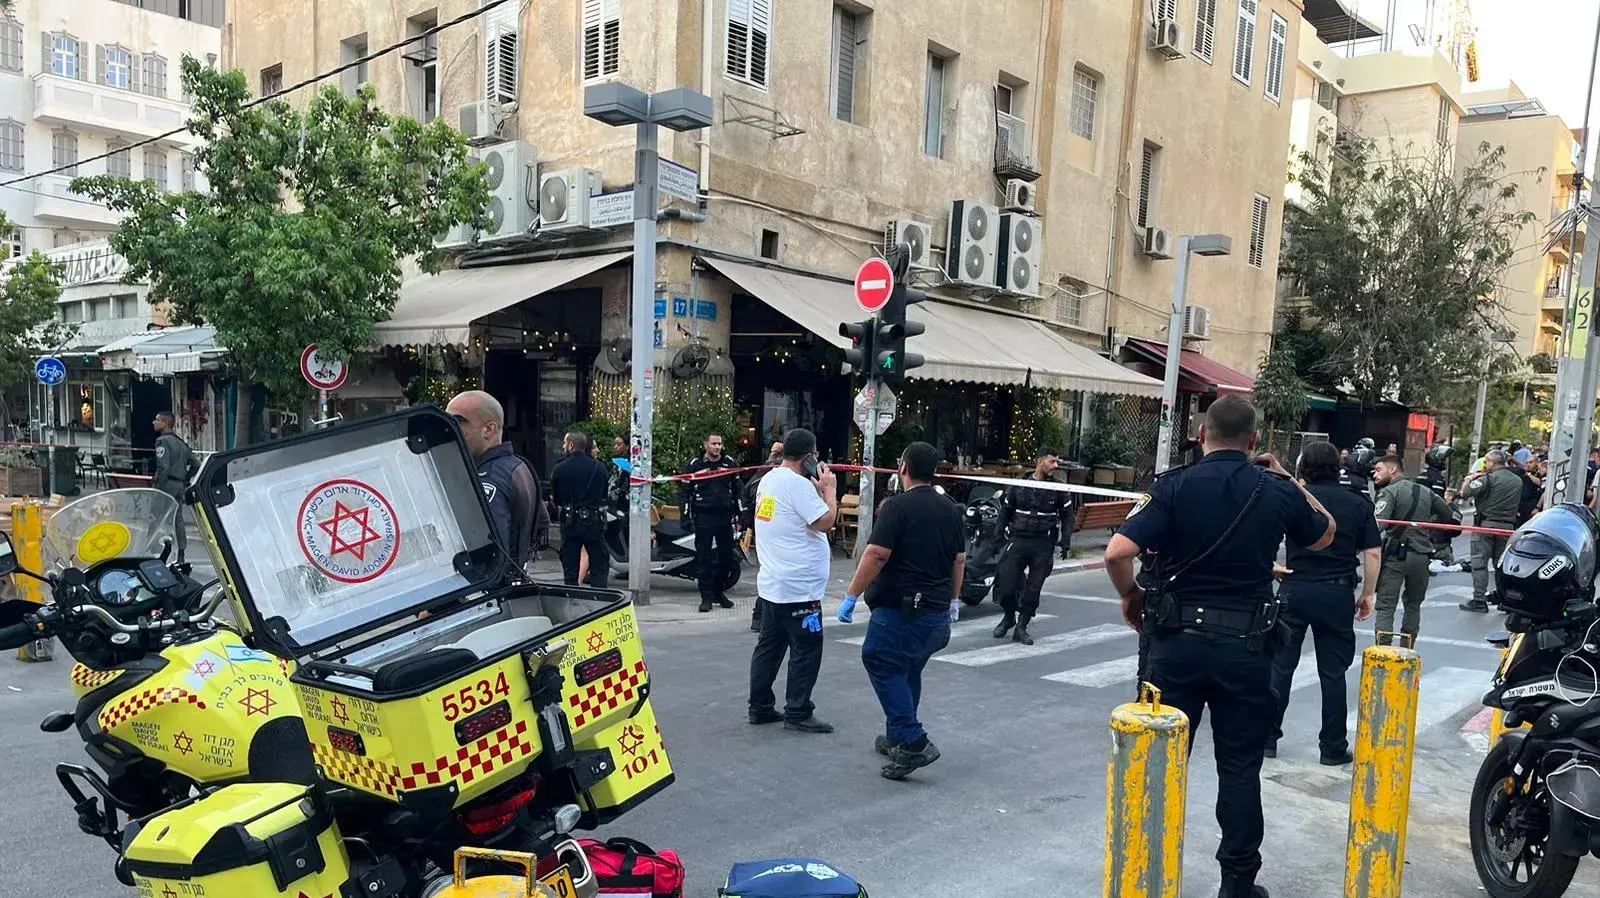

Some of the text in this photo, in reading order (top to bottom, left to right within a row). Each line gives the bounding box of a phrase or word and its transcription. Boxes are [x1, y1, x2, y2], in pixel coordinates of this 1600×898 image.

[674, 301, 686, 314] 17
[303, 486, 382, 531] מגן דוד אדום בישראל
[306, 511, 394, 576] MAGEN DAVID ADOM IN ISRAEL
[1541, 557, 1564, 577] SHOEI
[249, 673, 283, 687] מחכים
[1529, 683, 1555, 694] משטרת
[441, 671, 510, 722] 5534
[202, 733, 235, 747] מגן דוד
[199, 751, 233, 768] בישראל
[210, 746, 234, 758] אדום
[621, 749, 659, 779] 101
